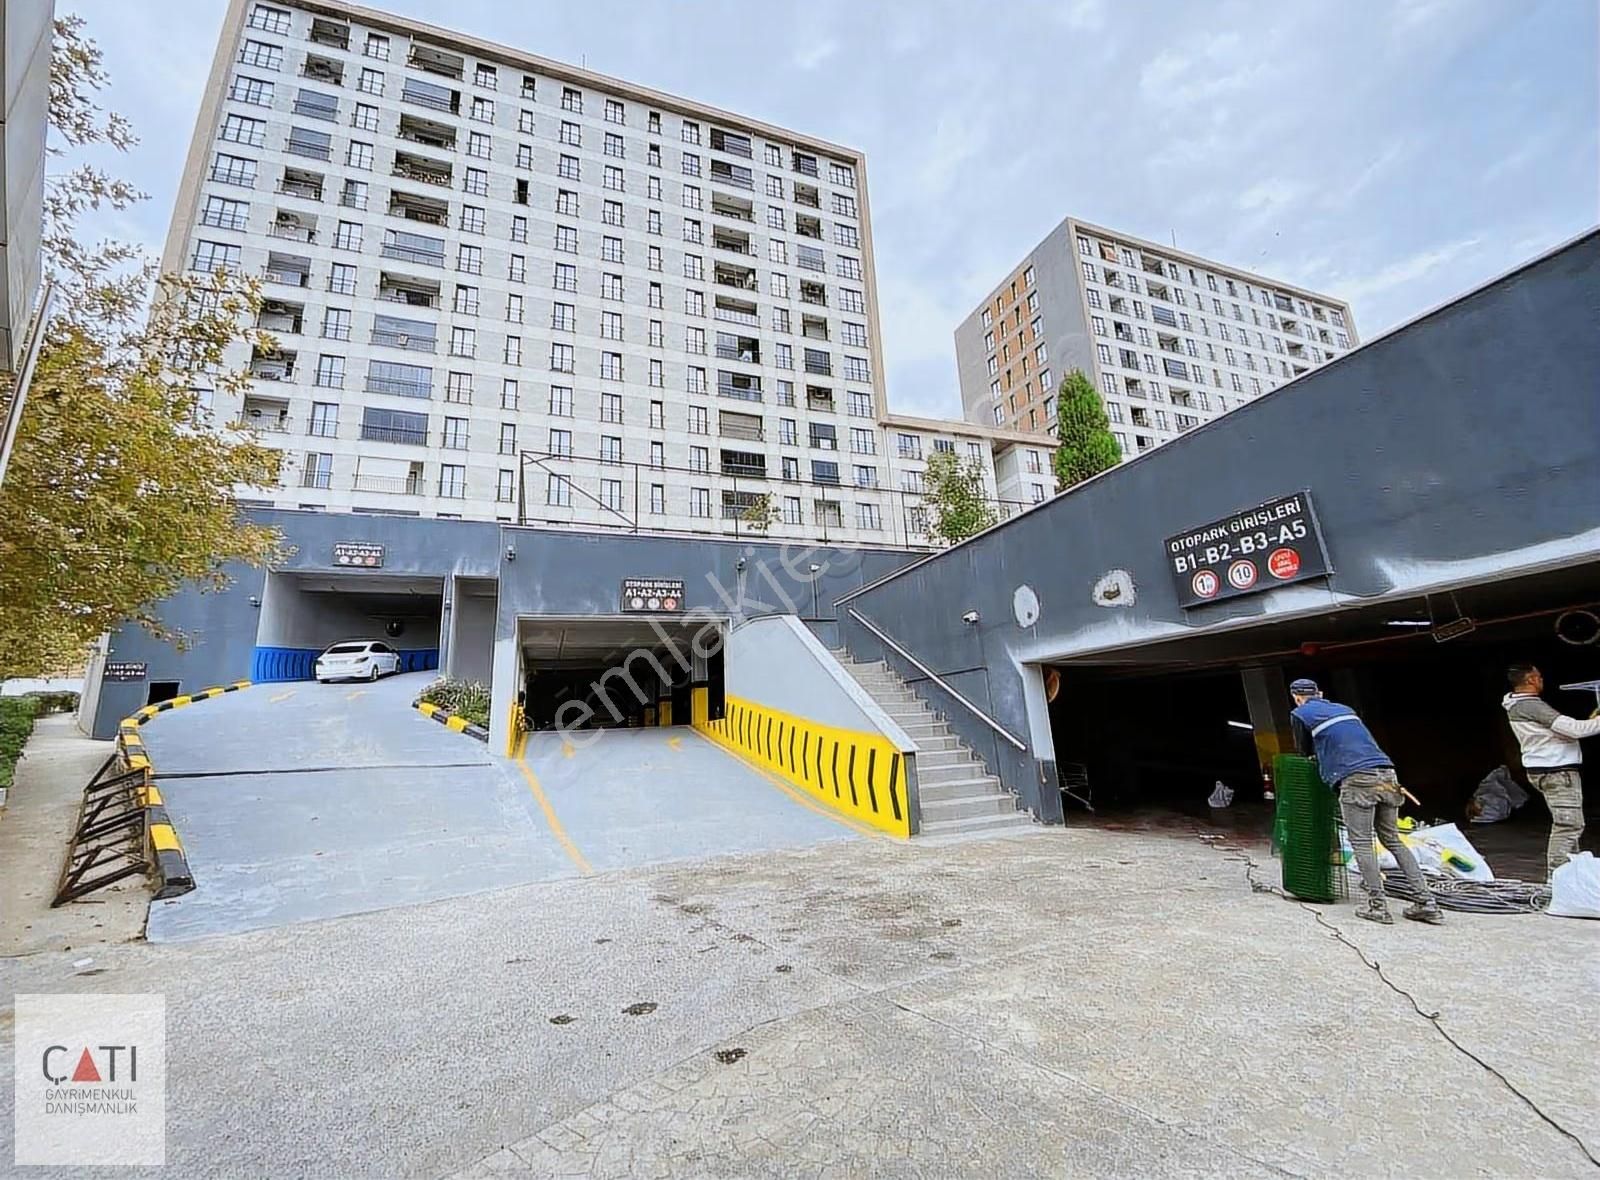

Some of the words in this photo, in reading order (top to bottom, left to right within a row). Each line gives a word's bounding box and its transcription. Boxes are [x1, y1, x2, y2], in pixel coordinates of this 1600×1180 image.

[1171, 527, 1229, 553] OTOPARK
[1230, 496, 1302, 534] GİRİŞLERİ
[1174, 519, 1308, 574] B1-B2-B3-A5
[1235, 565, 1251, 581] 10
